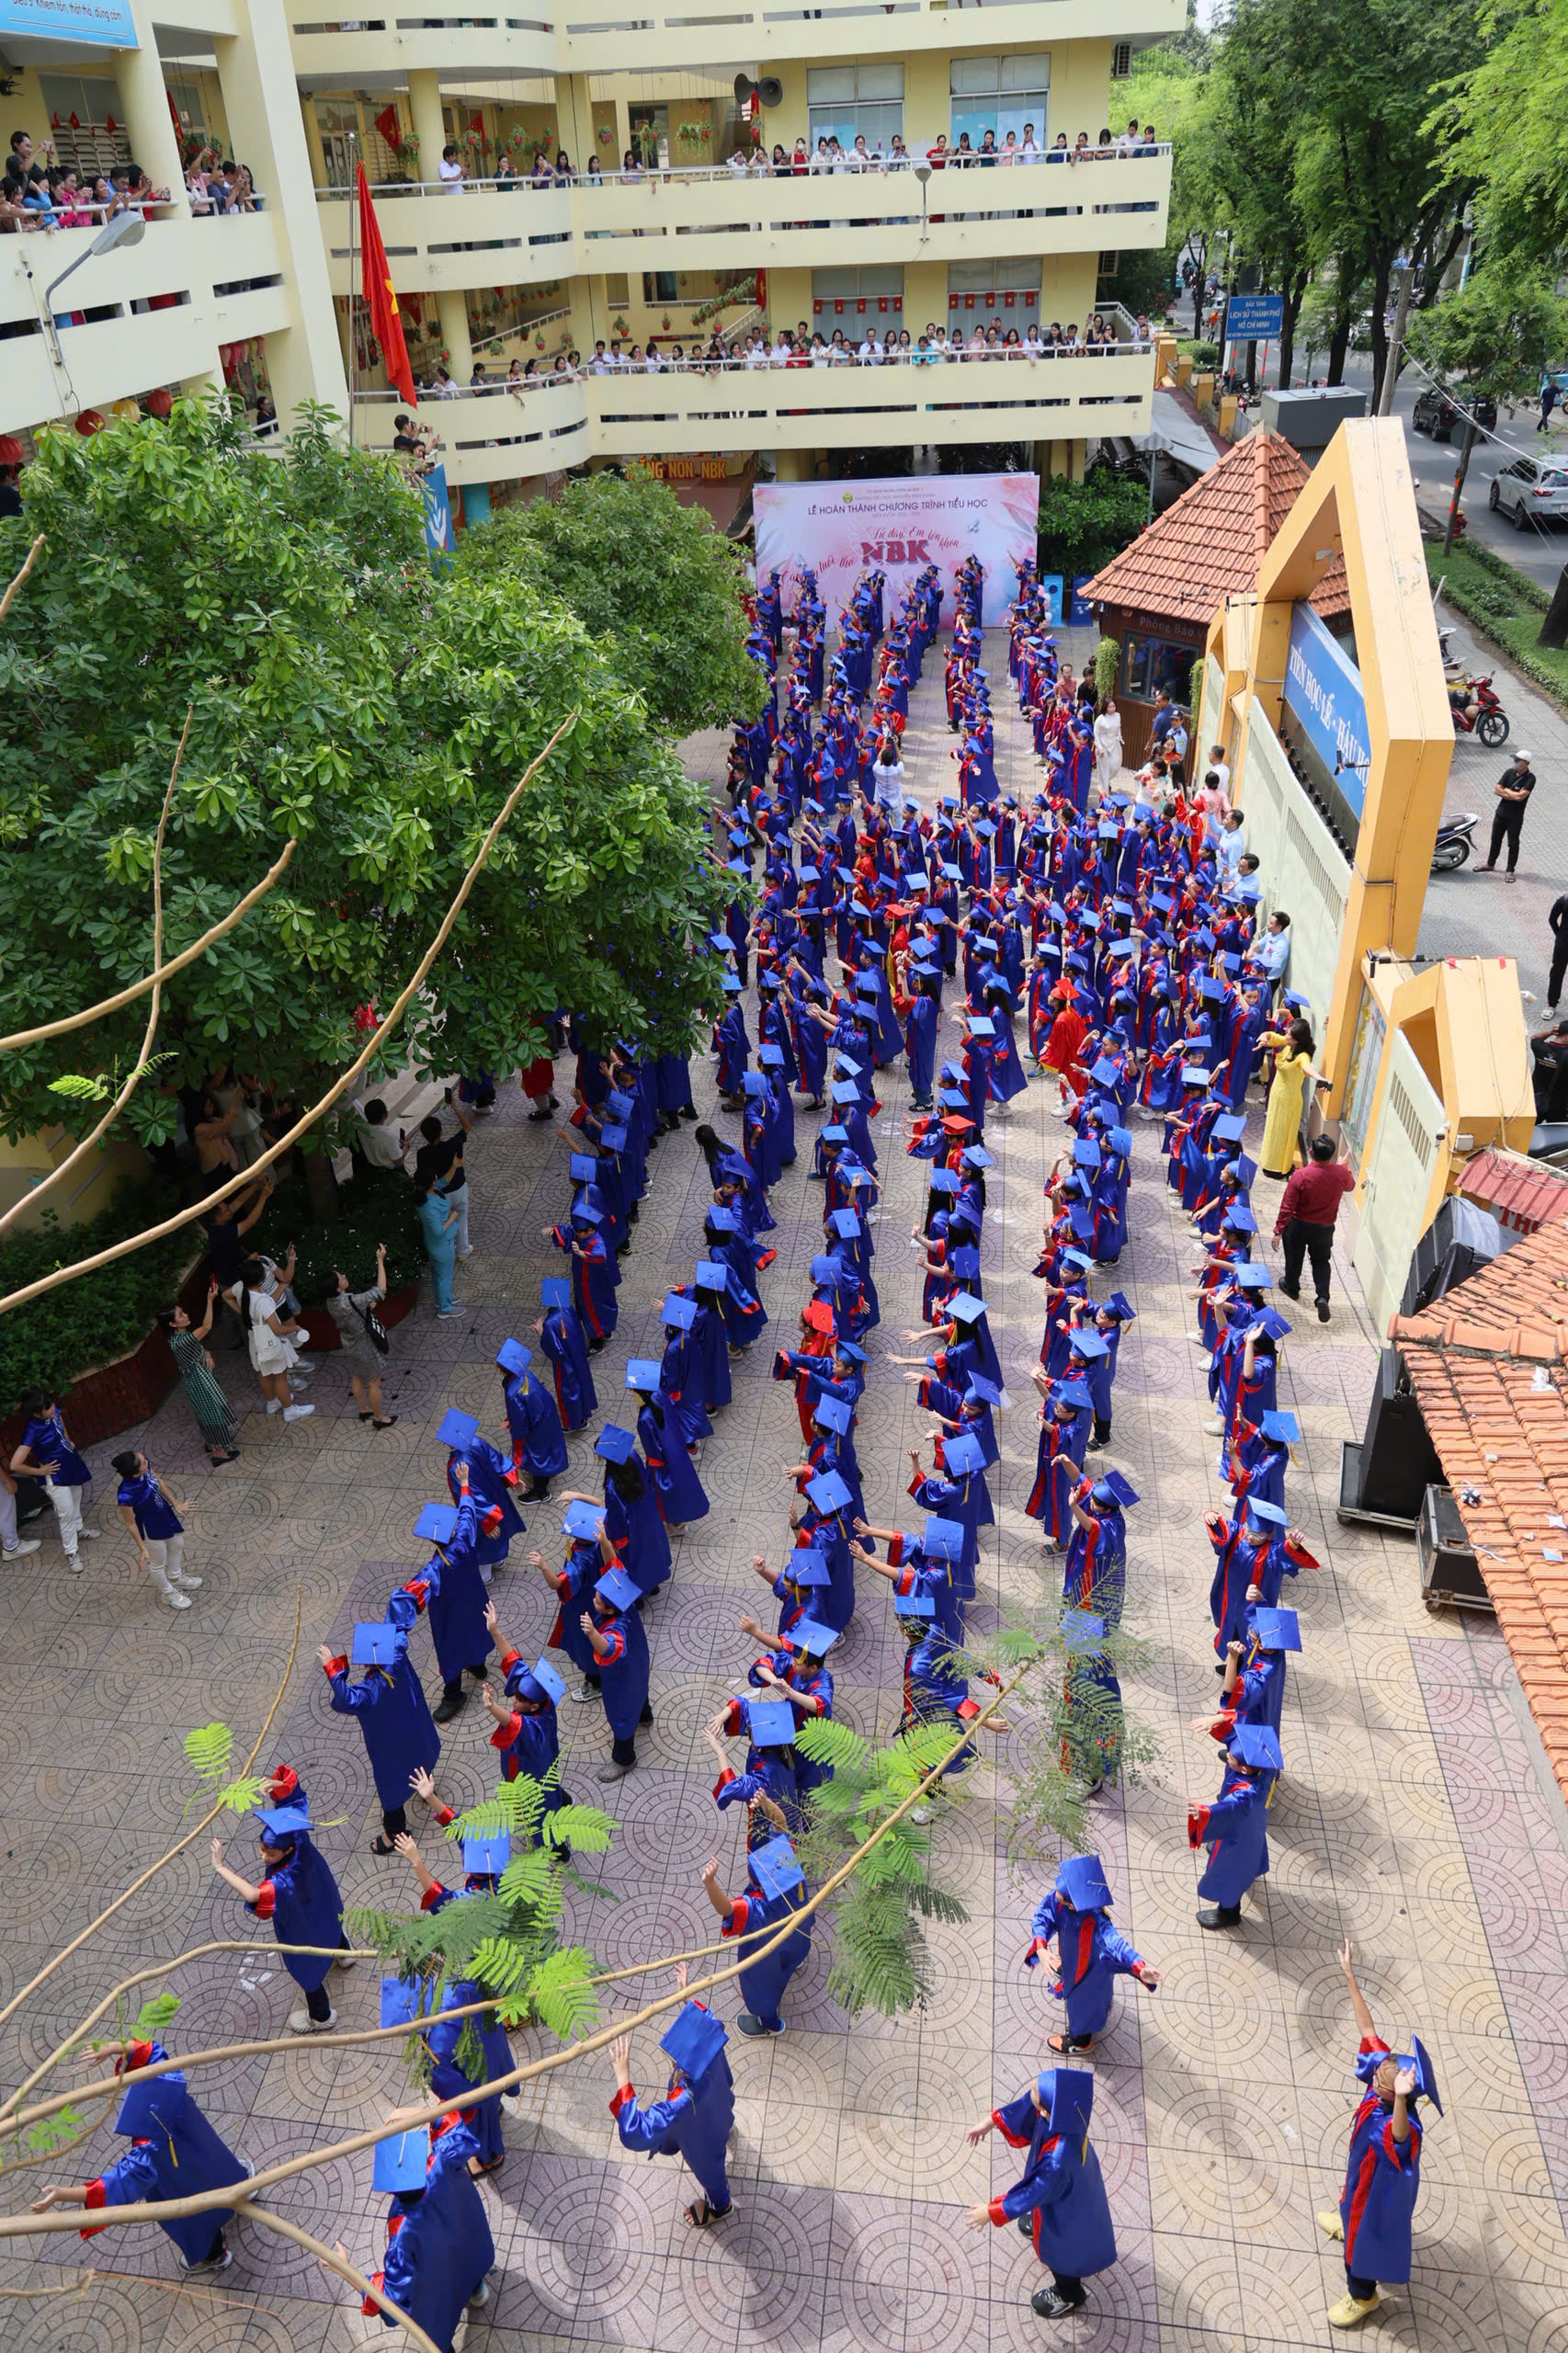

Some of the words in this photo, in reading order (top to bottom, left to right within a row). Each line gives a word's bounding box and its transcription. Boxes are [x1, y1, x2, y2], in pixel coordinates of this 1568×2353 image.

[1256, 320, 1270, 329] MINH
[626, 455, 664, 479] MNG
[668, 460, 694, 479] NON
[700, 460, 727, 479] NBK
[808, 504, 817, 516] LỄ
[819, 502, 846, 515] HOÀN
[847, 500, 877, 513] THÀNH
[879, 502, 919, 512] CHƯƠNG
[921, 499, 946, 510] TRÌNH
[948, 497, 965, 508] TIỂU
[967, 499, 988, 508] HỌC
[909, 526, 925, 538] Em
[860, 539, 931, 565] NBK
[1140, 616, 1170, 633] Phòng
[1174, 623, 1195, 637] Bảo
[1290, 644, 1307, 690] TIÊN
[1304, 669, 1324, 712] HỌC
[1320, 691, 1335, 731] LỄ
[1355, 748, 1370, 795] HỌ
